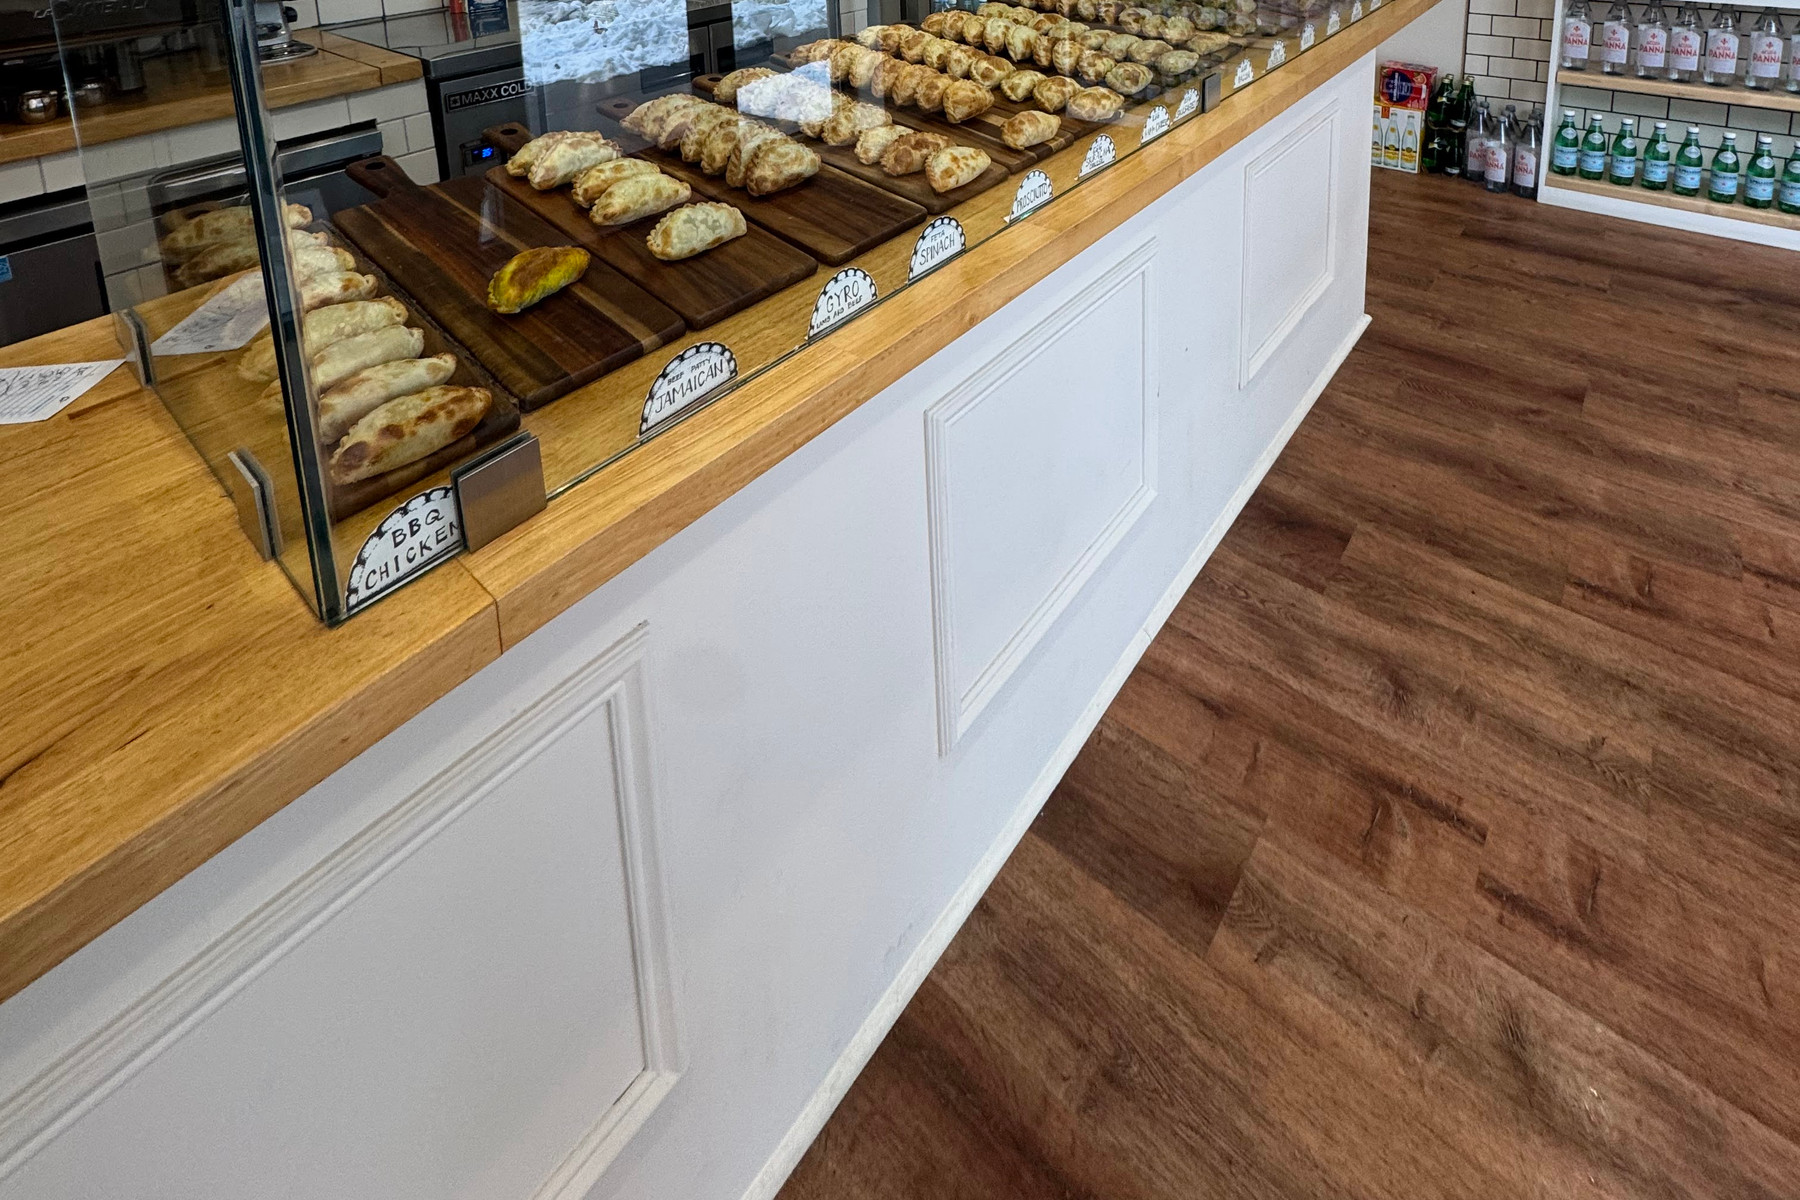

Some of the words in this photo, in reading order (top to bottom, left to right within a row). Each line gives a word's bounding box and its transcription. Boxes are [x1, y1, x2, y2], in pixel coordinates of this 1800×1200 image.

[1671, 46, 1698, 57] PANNA
[1708, 49, 1736, 60] PANNA
[461, 87, 498, 106] MAXX
[500, 79, 533, 98] COLD
[919, 233, 956, 266] SPINACH
[826, 280, 860, 314] GYRO
[690, 356, 712, 372] PATTY
[654, 358, 724, 414] JAMAICAN
[391, 508, 445, 549] BBQ
